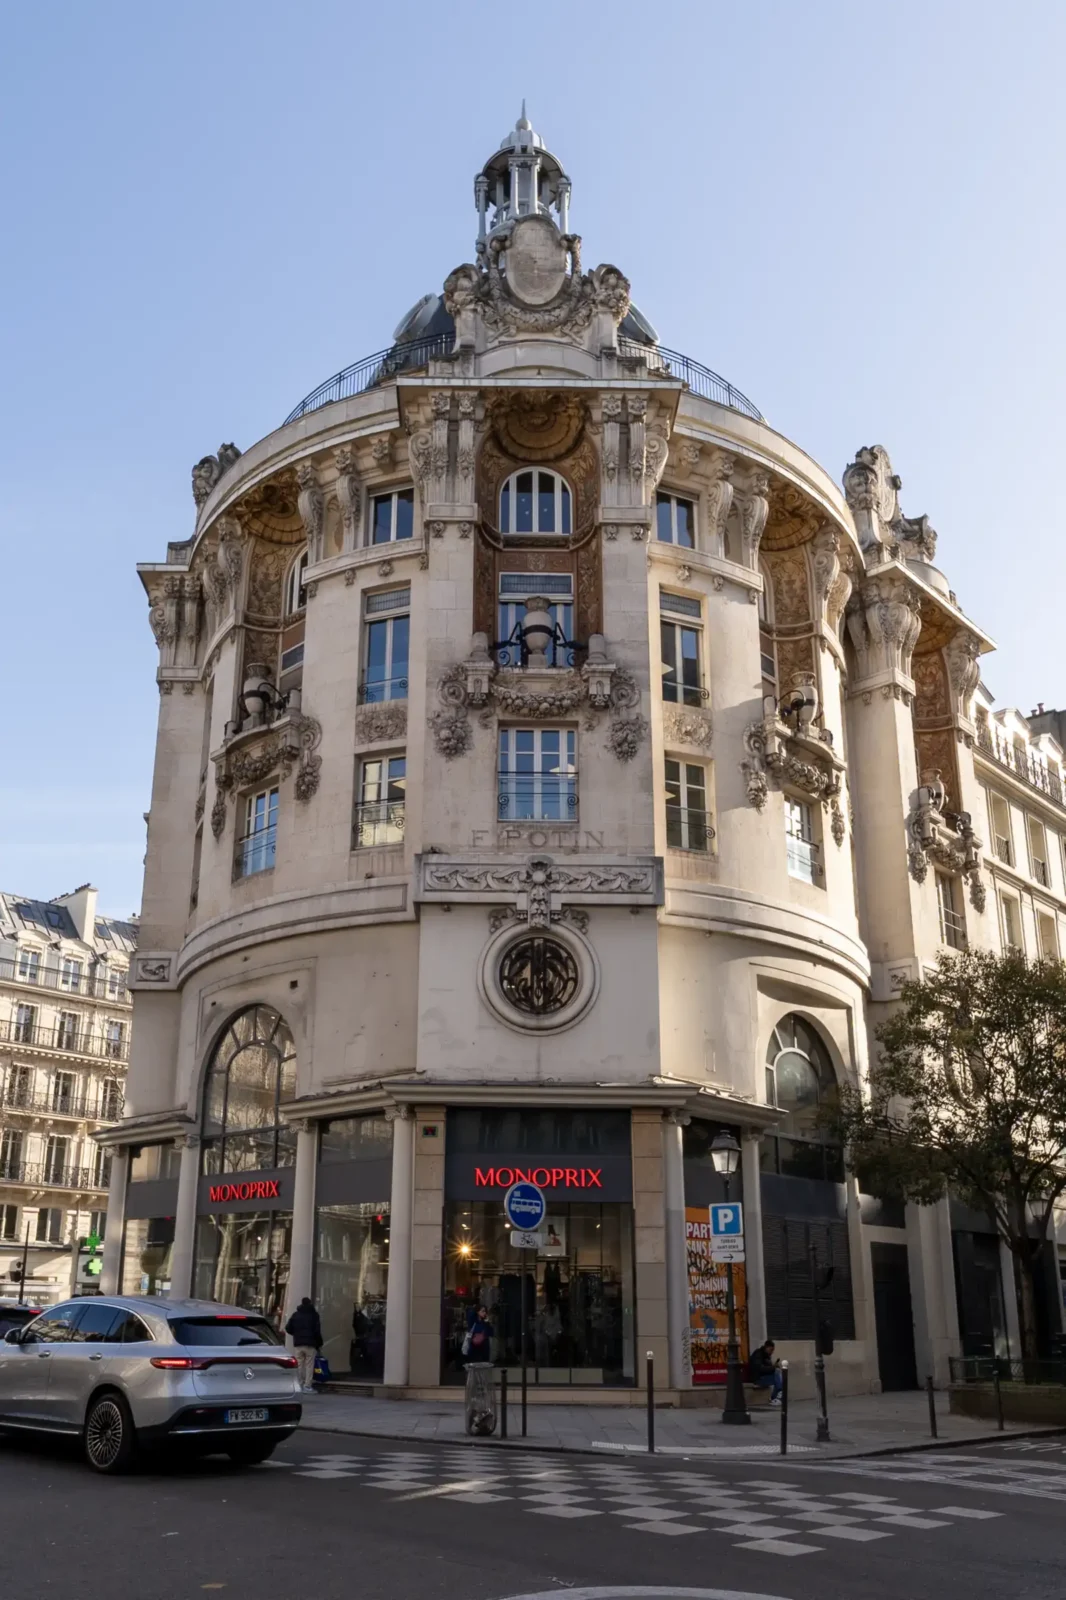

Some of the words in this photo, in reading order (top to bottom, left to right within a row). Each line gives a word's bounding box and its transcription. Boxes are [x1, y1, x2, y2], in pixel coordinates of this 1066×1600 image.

[504, 829, 605, 848] POTIN
[474, 1167, 602, 1188] MONOPRIX
[209, 1180, 279, 1202] MONOPRIX
[717, 1208, 733, 1232] P
